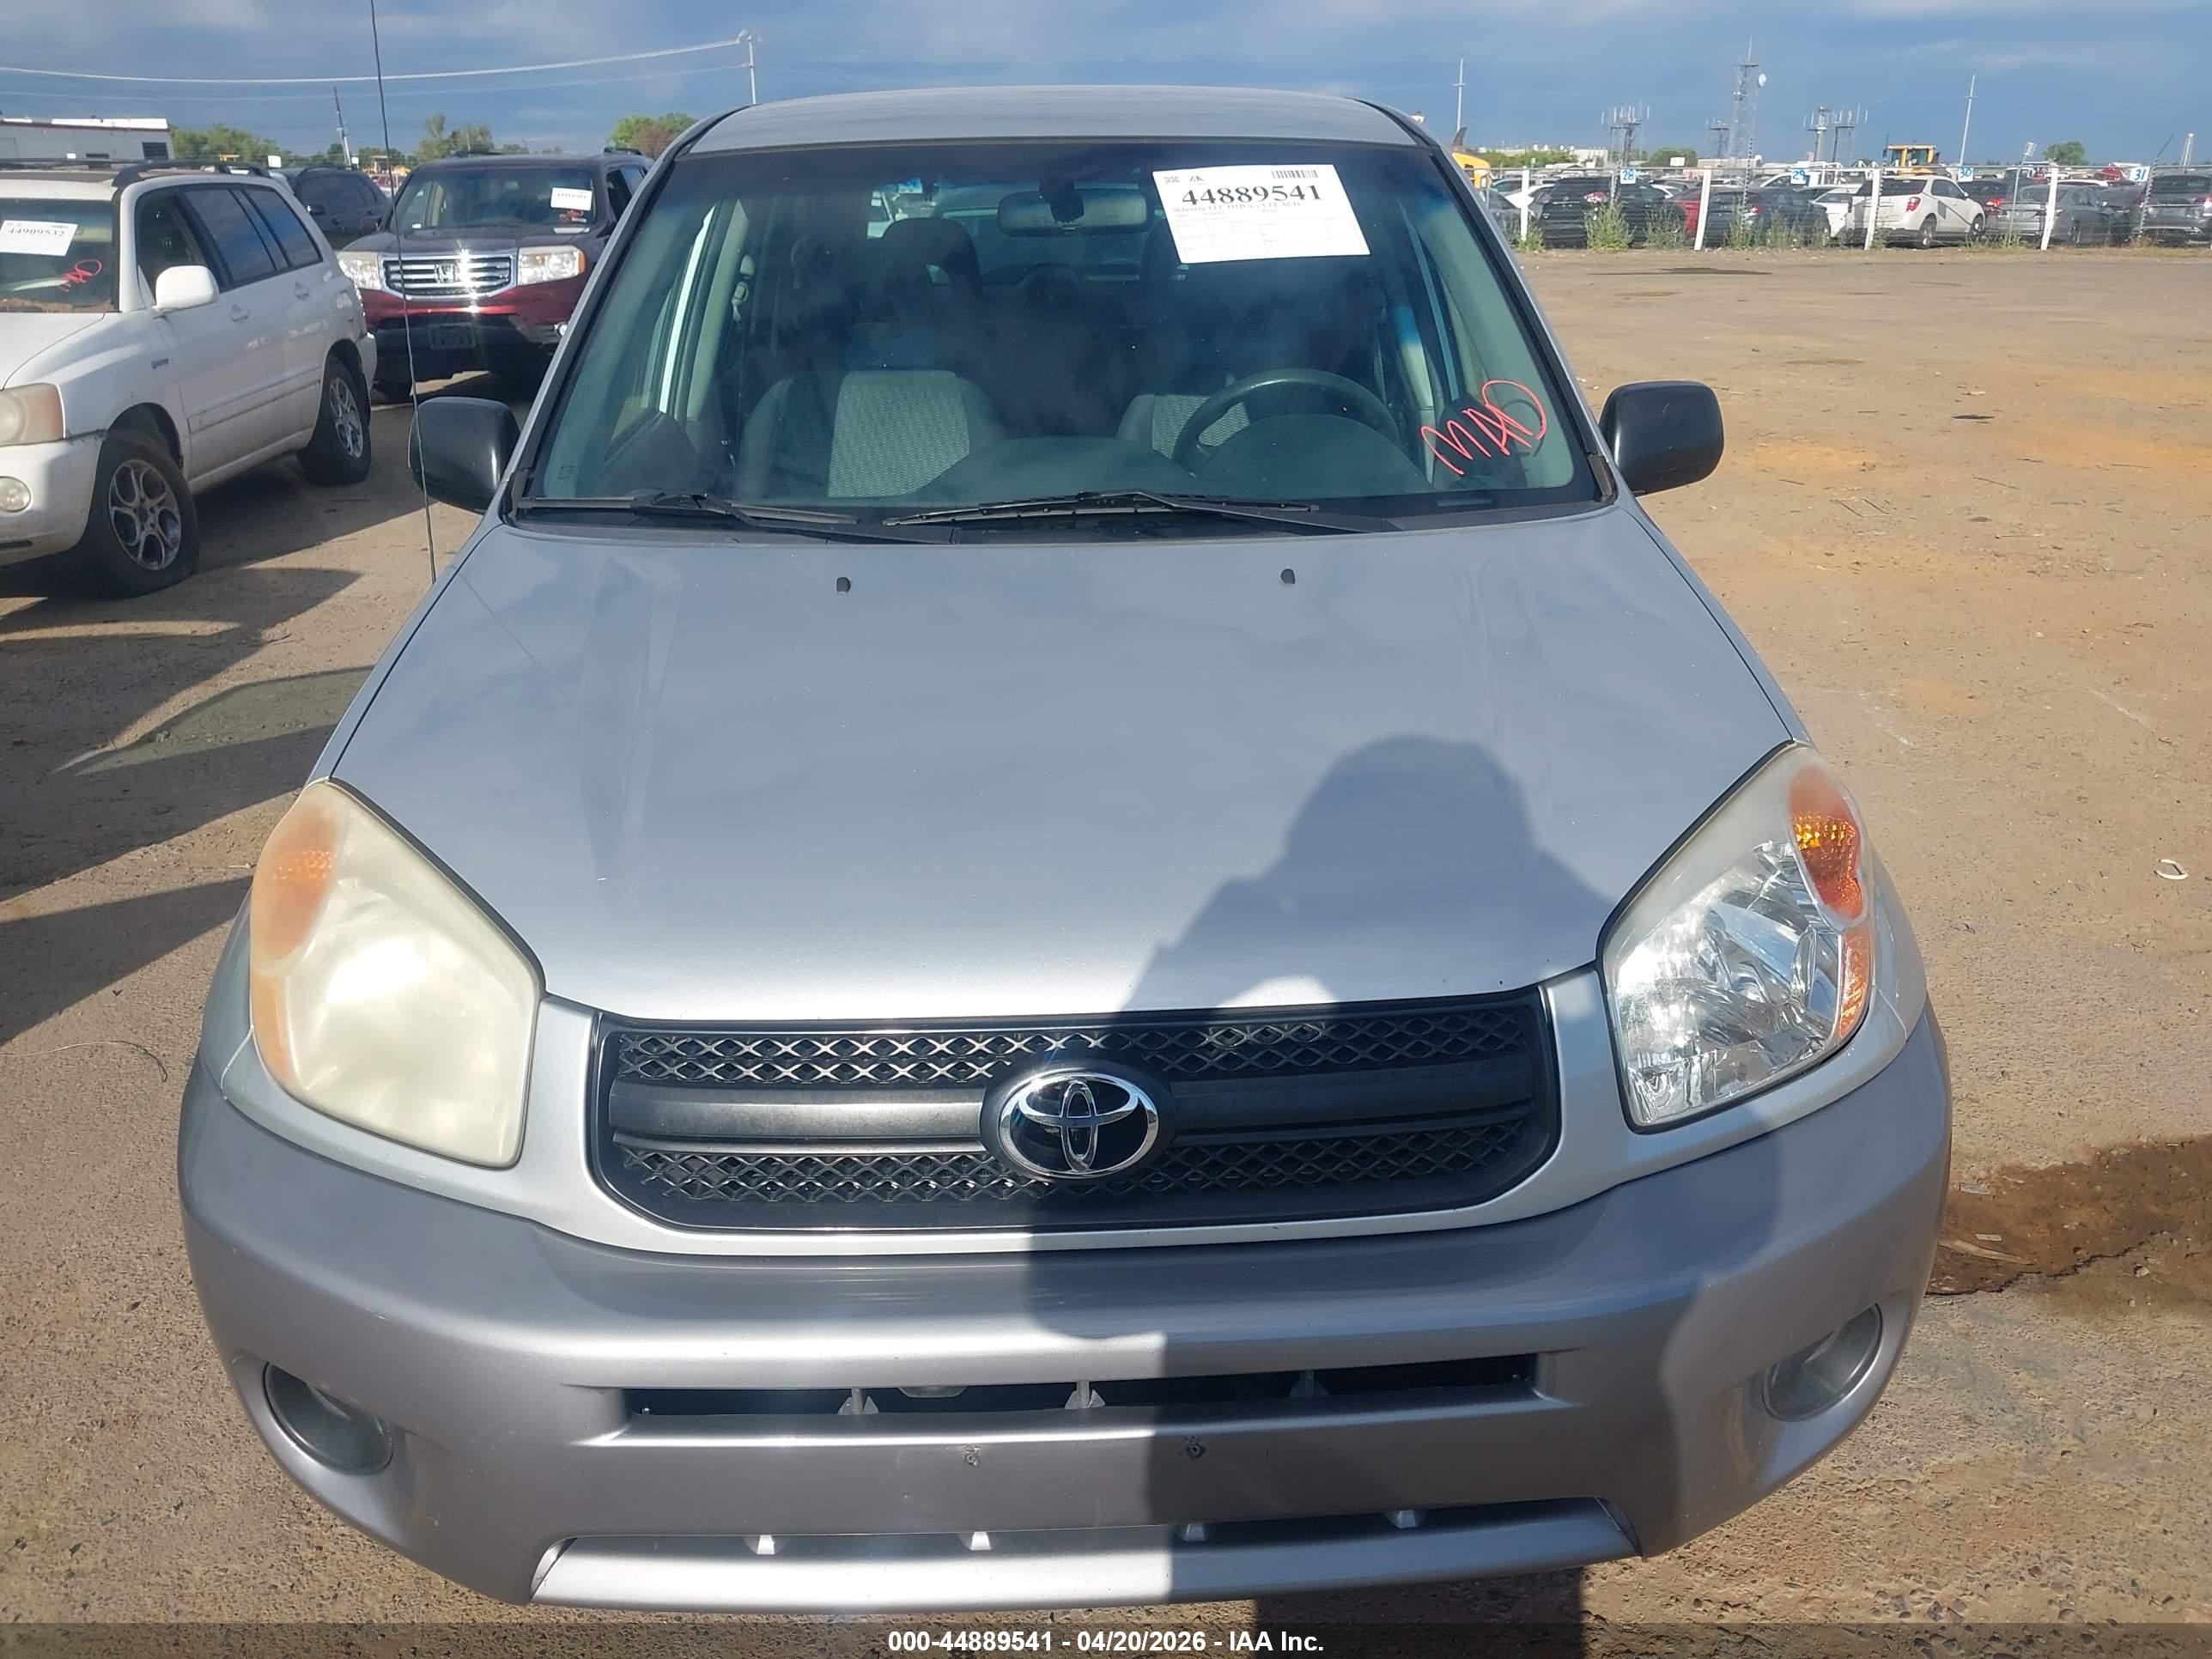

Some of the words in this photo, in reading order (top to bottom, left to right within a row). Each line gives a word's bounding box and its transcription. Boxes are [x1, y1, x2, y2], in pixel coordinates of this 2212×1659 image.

[1622, 168, 1634, 180] 28
[1792, 168, 1806, 180] 29
[1960, 167, 1972, 179] 30
[2134, 168, 2147, 180] 31
[1182, 185, 1323, 205] 44889541
